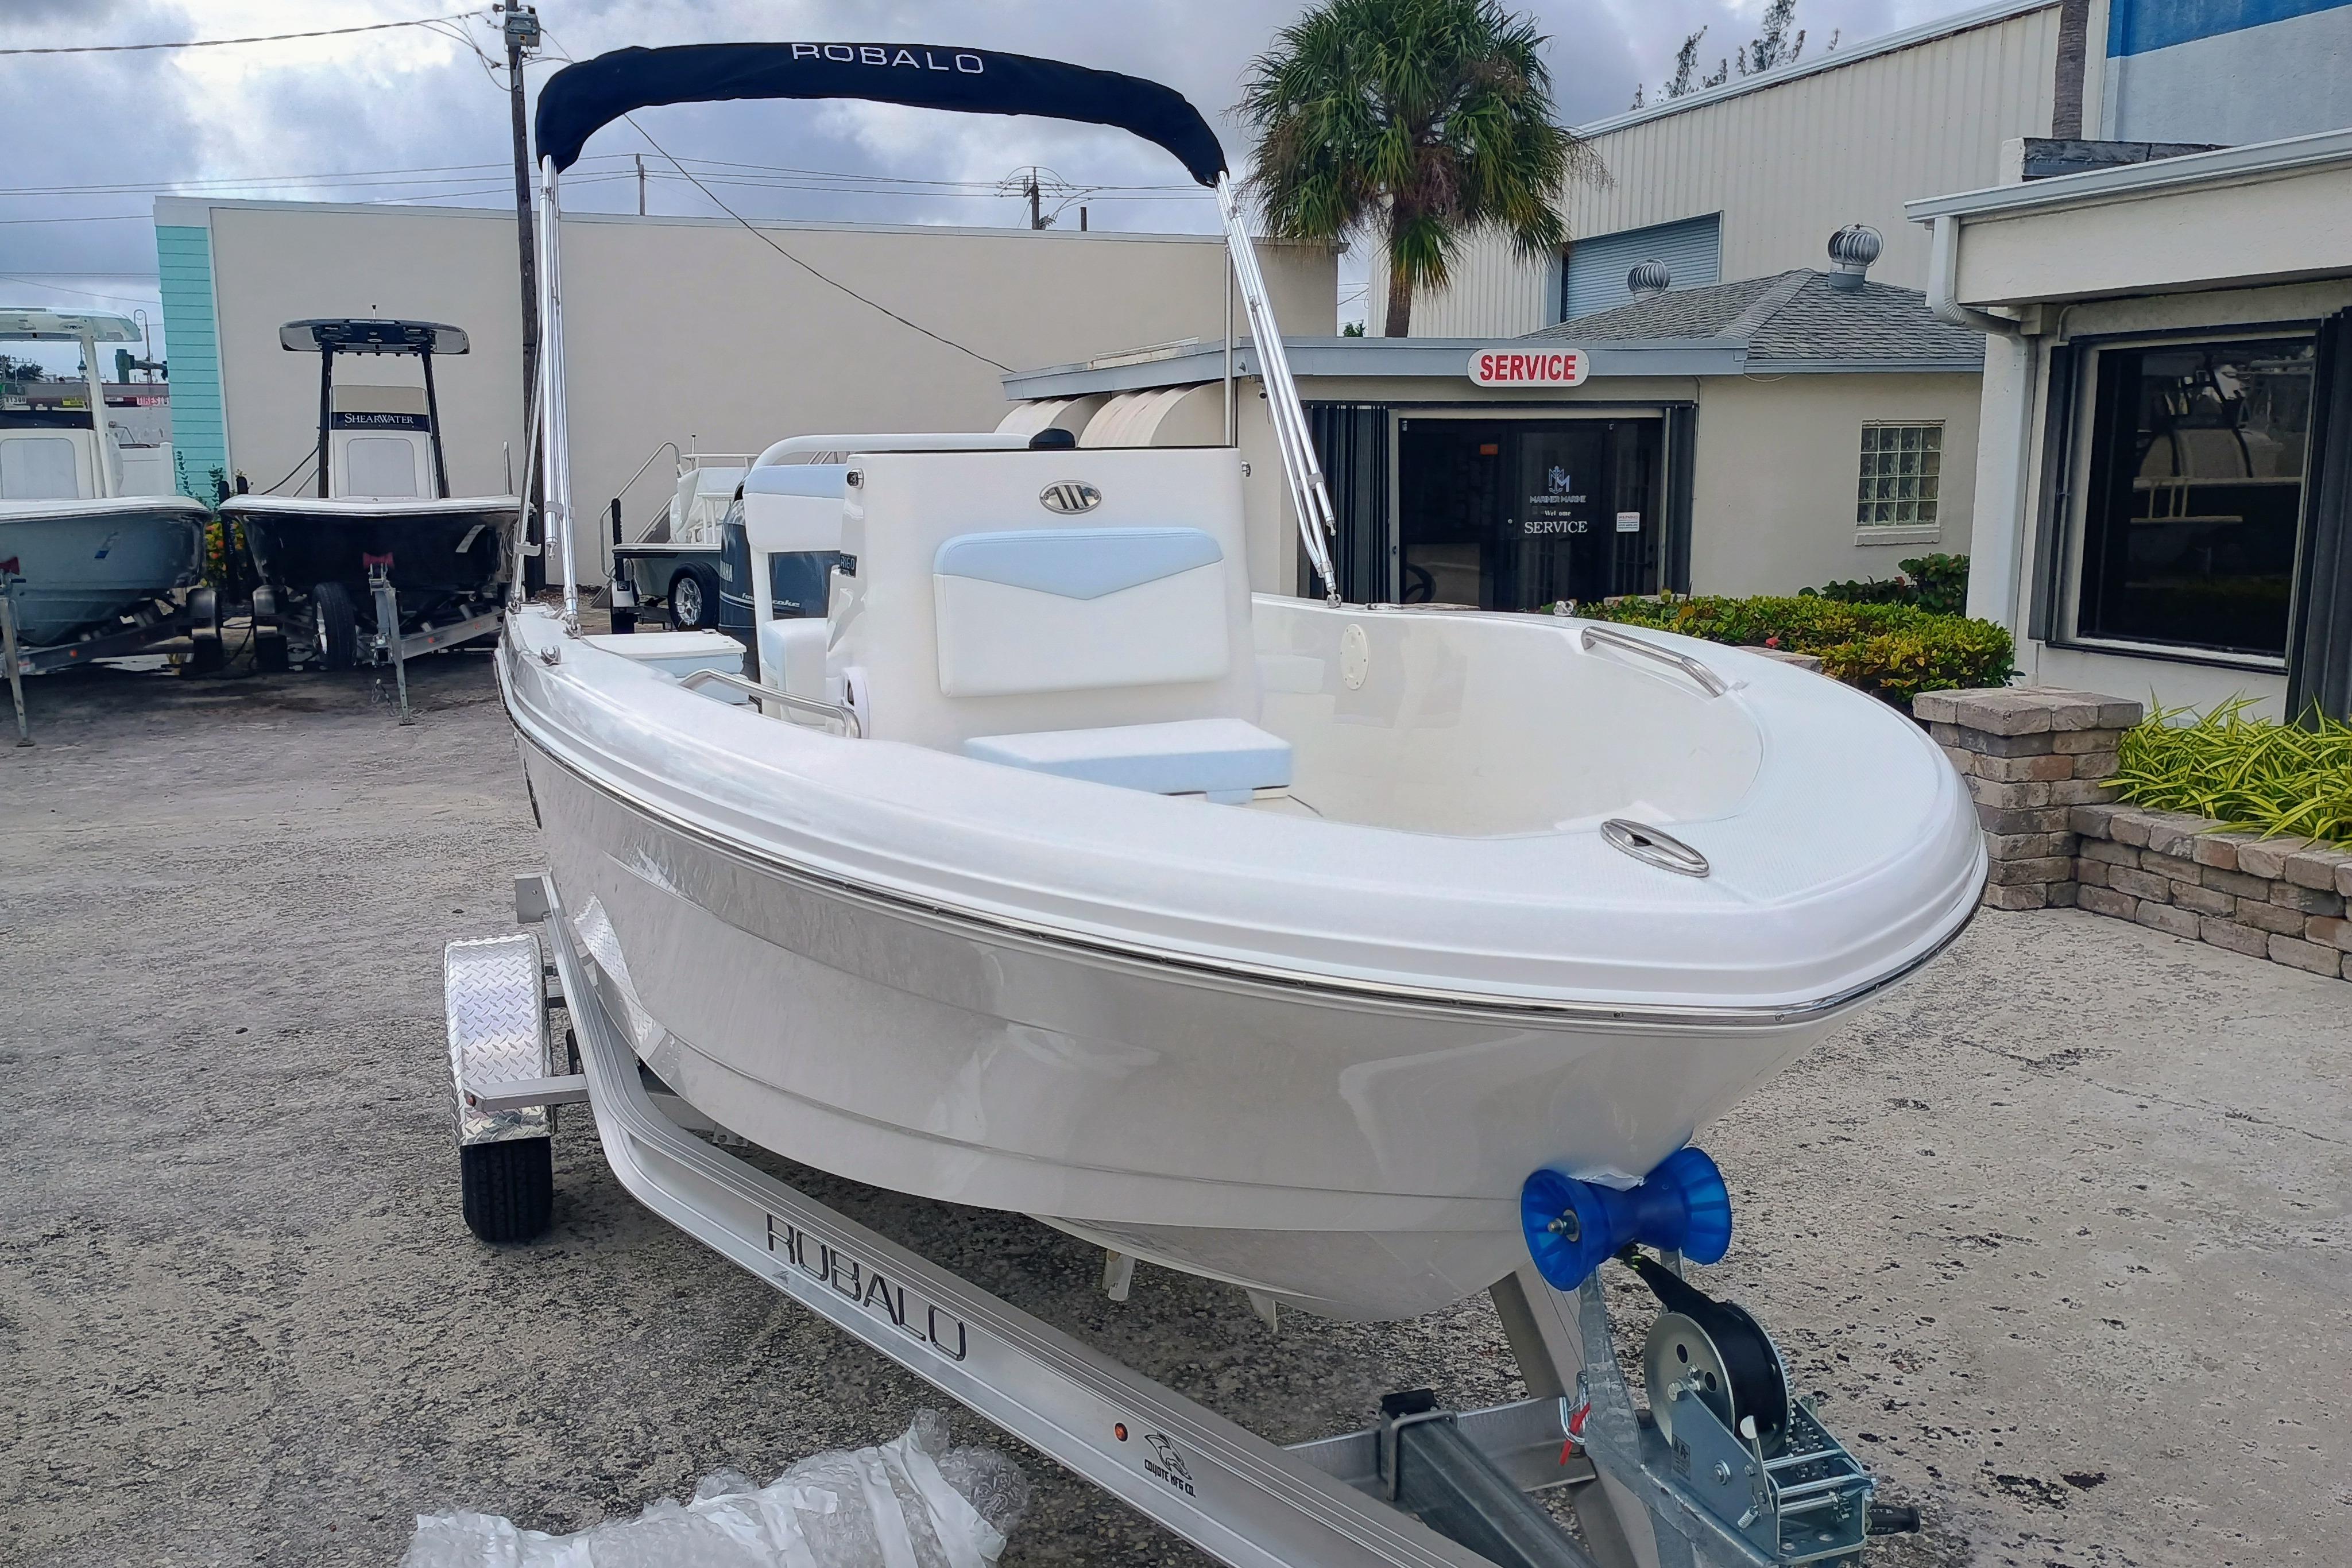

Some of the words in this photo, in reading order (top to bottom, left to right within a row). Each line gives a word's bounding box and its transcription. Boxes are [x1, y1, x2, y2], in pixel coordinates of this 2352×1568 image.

[791, 44, 984, 73] ROBALO
[1480, 354, 1577, 381] SERVICE
[1525, 521, 1588, 533] SERVICE
[841, 556, 855, 570] R160
[767, 1213, 966, 1361] ROBALO
[1144, 1459, 1170, 1482] COYOTE
[1170, 1473, 1184, 1491] MFG
[1185, 1483, 1197, 1498] CO.
